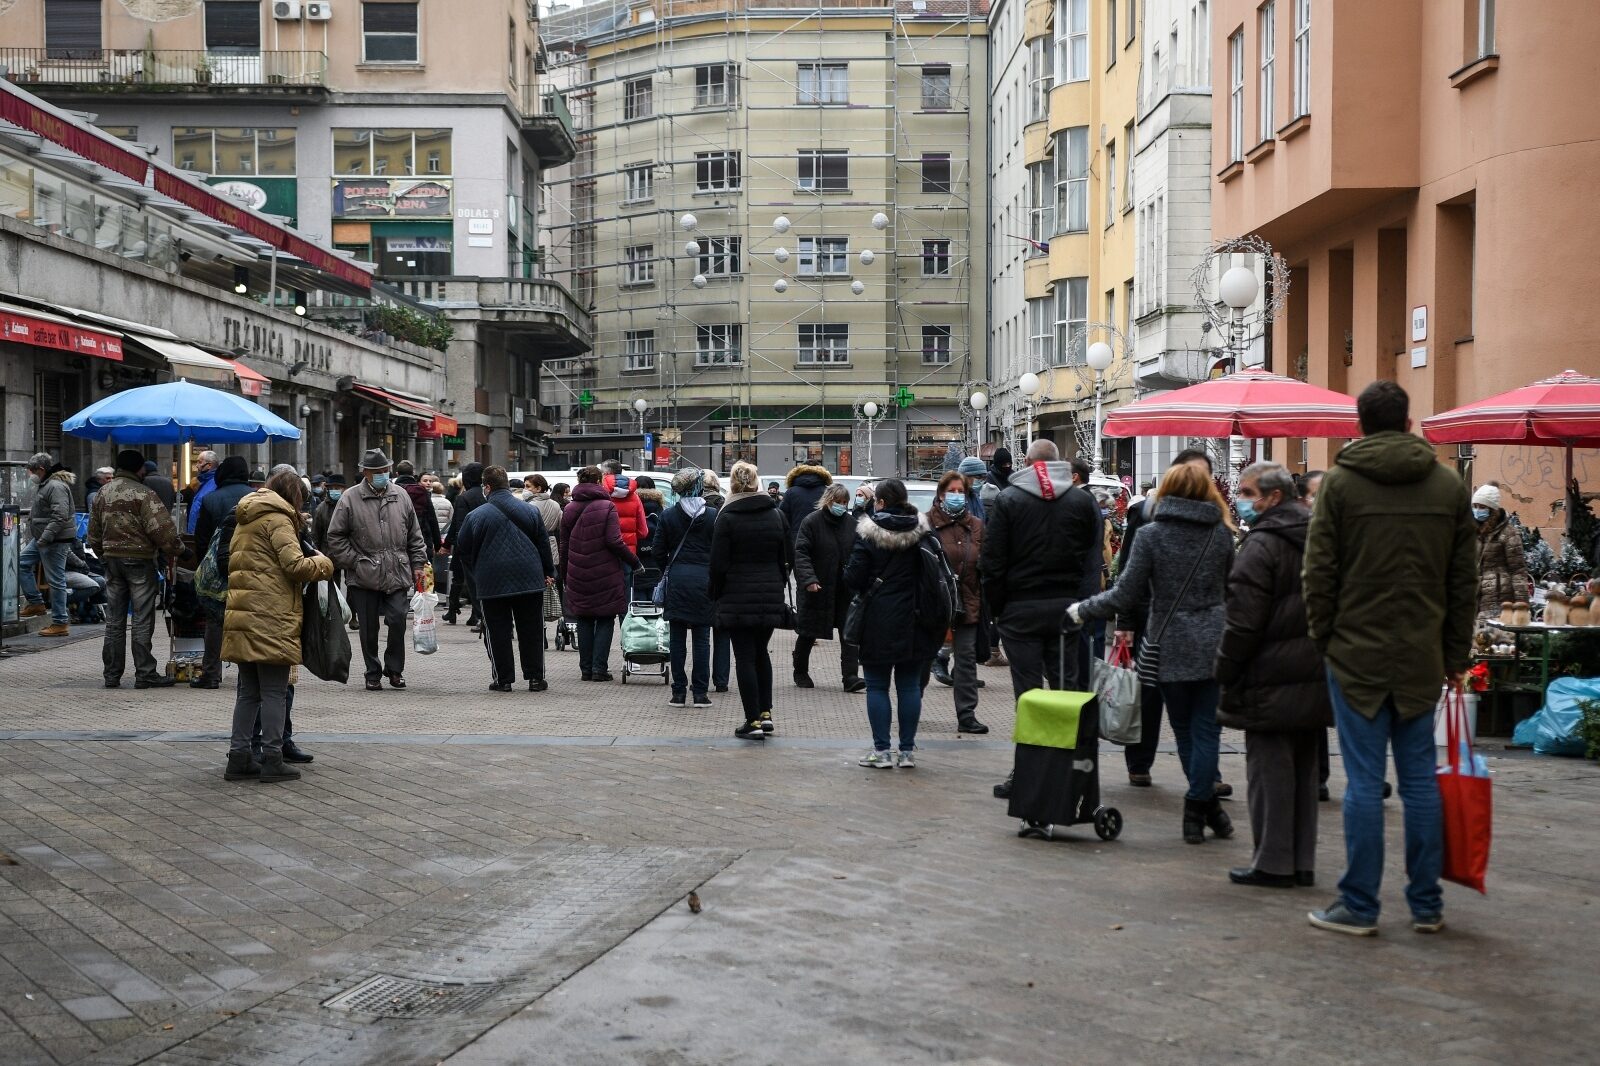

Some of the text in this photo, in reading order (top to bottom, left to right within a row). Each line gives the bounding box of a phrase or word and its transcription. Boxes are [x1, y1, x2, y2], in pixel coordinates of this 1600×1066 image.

[457, 208, 489, 218] DOLAC
[223, 316, 332, 370] TRŽNICA DOLAC
